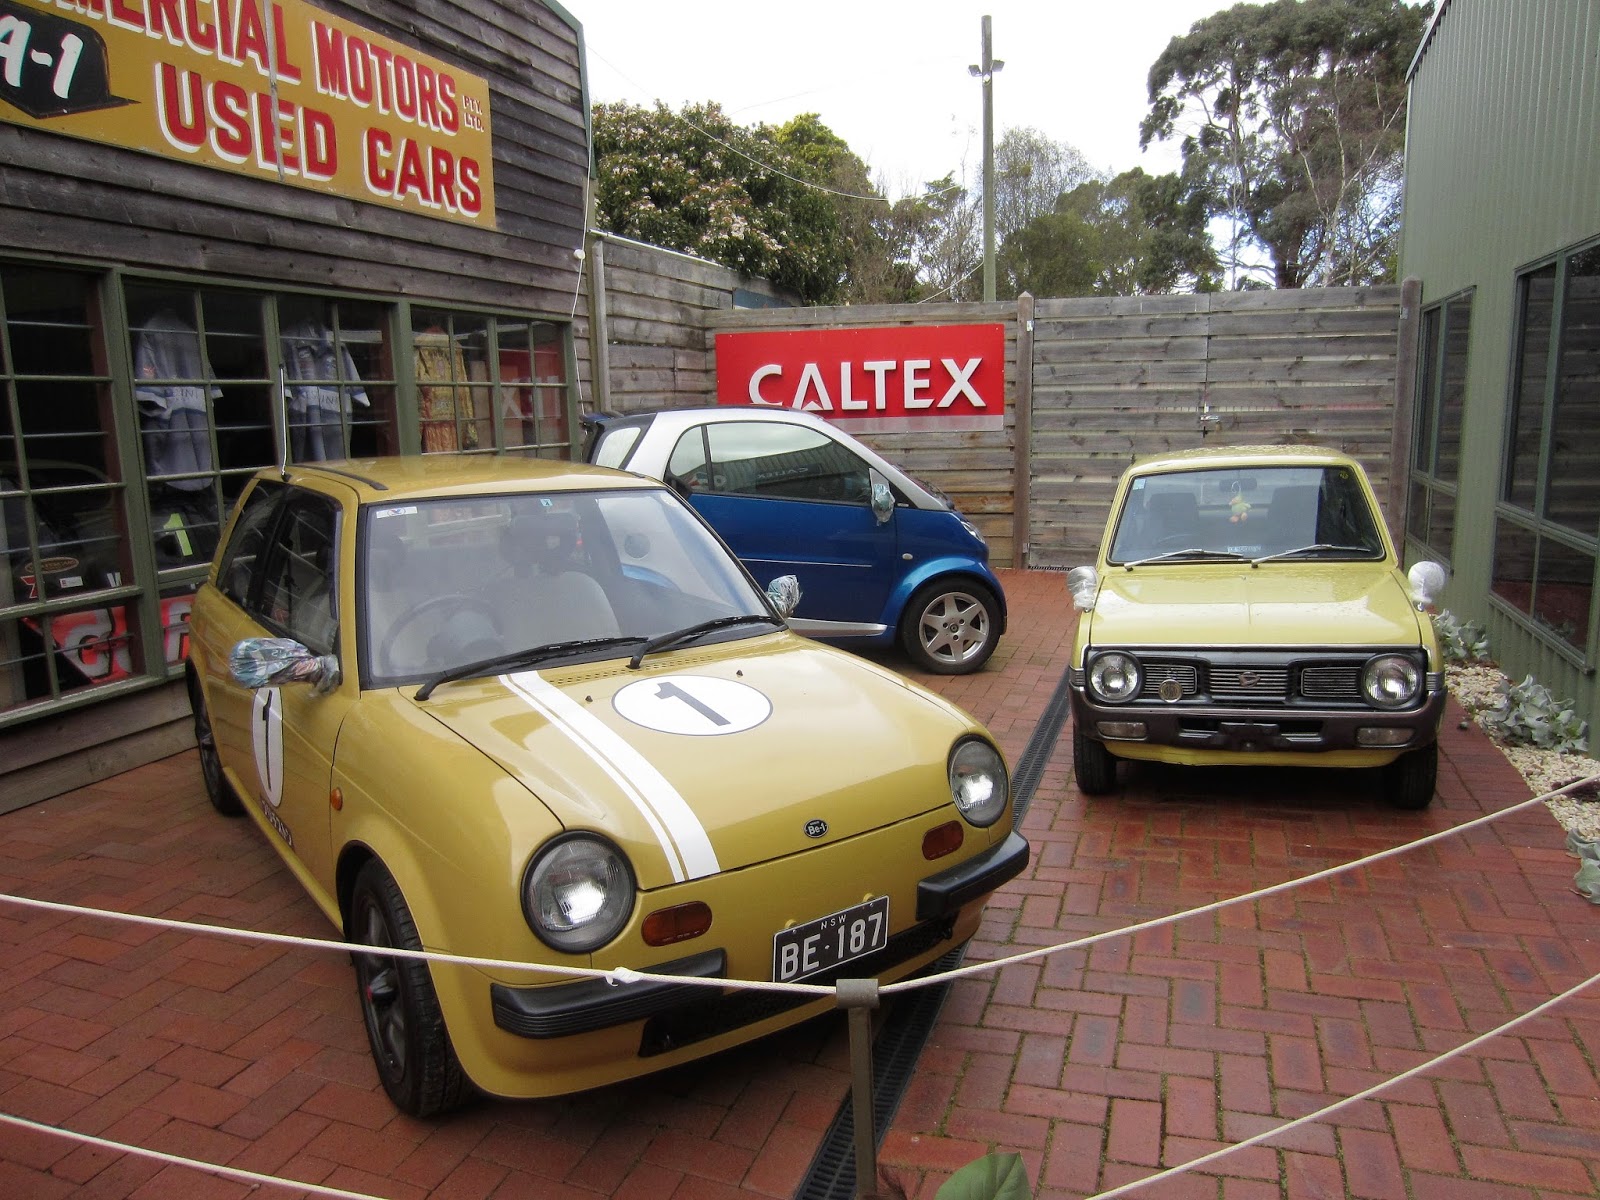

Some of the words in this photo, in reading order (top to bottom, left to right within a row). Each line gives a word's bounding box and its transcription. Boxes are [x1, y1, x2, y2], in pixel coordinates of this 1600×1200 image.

[0, 15, 84, 99] A-1
[55, 0, 301, 86] RCIAL
[311, 21, 459, 137] MOTORS
[154, 61, 338, 182] USED
[363, 126, 483, 218] CARS
[748, 357, 986, 411] CALTEX
[654, 681, 731, 727] 1
[808, 822, 826, 835] Be-1
[820, 913, 847, 931] NSW
